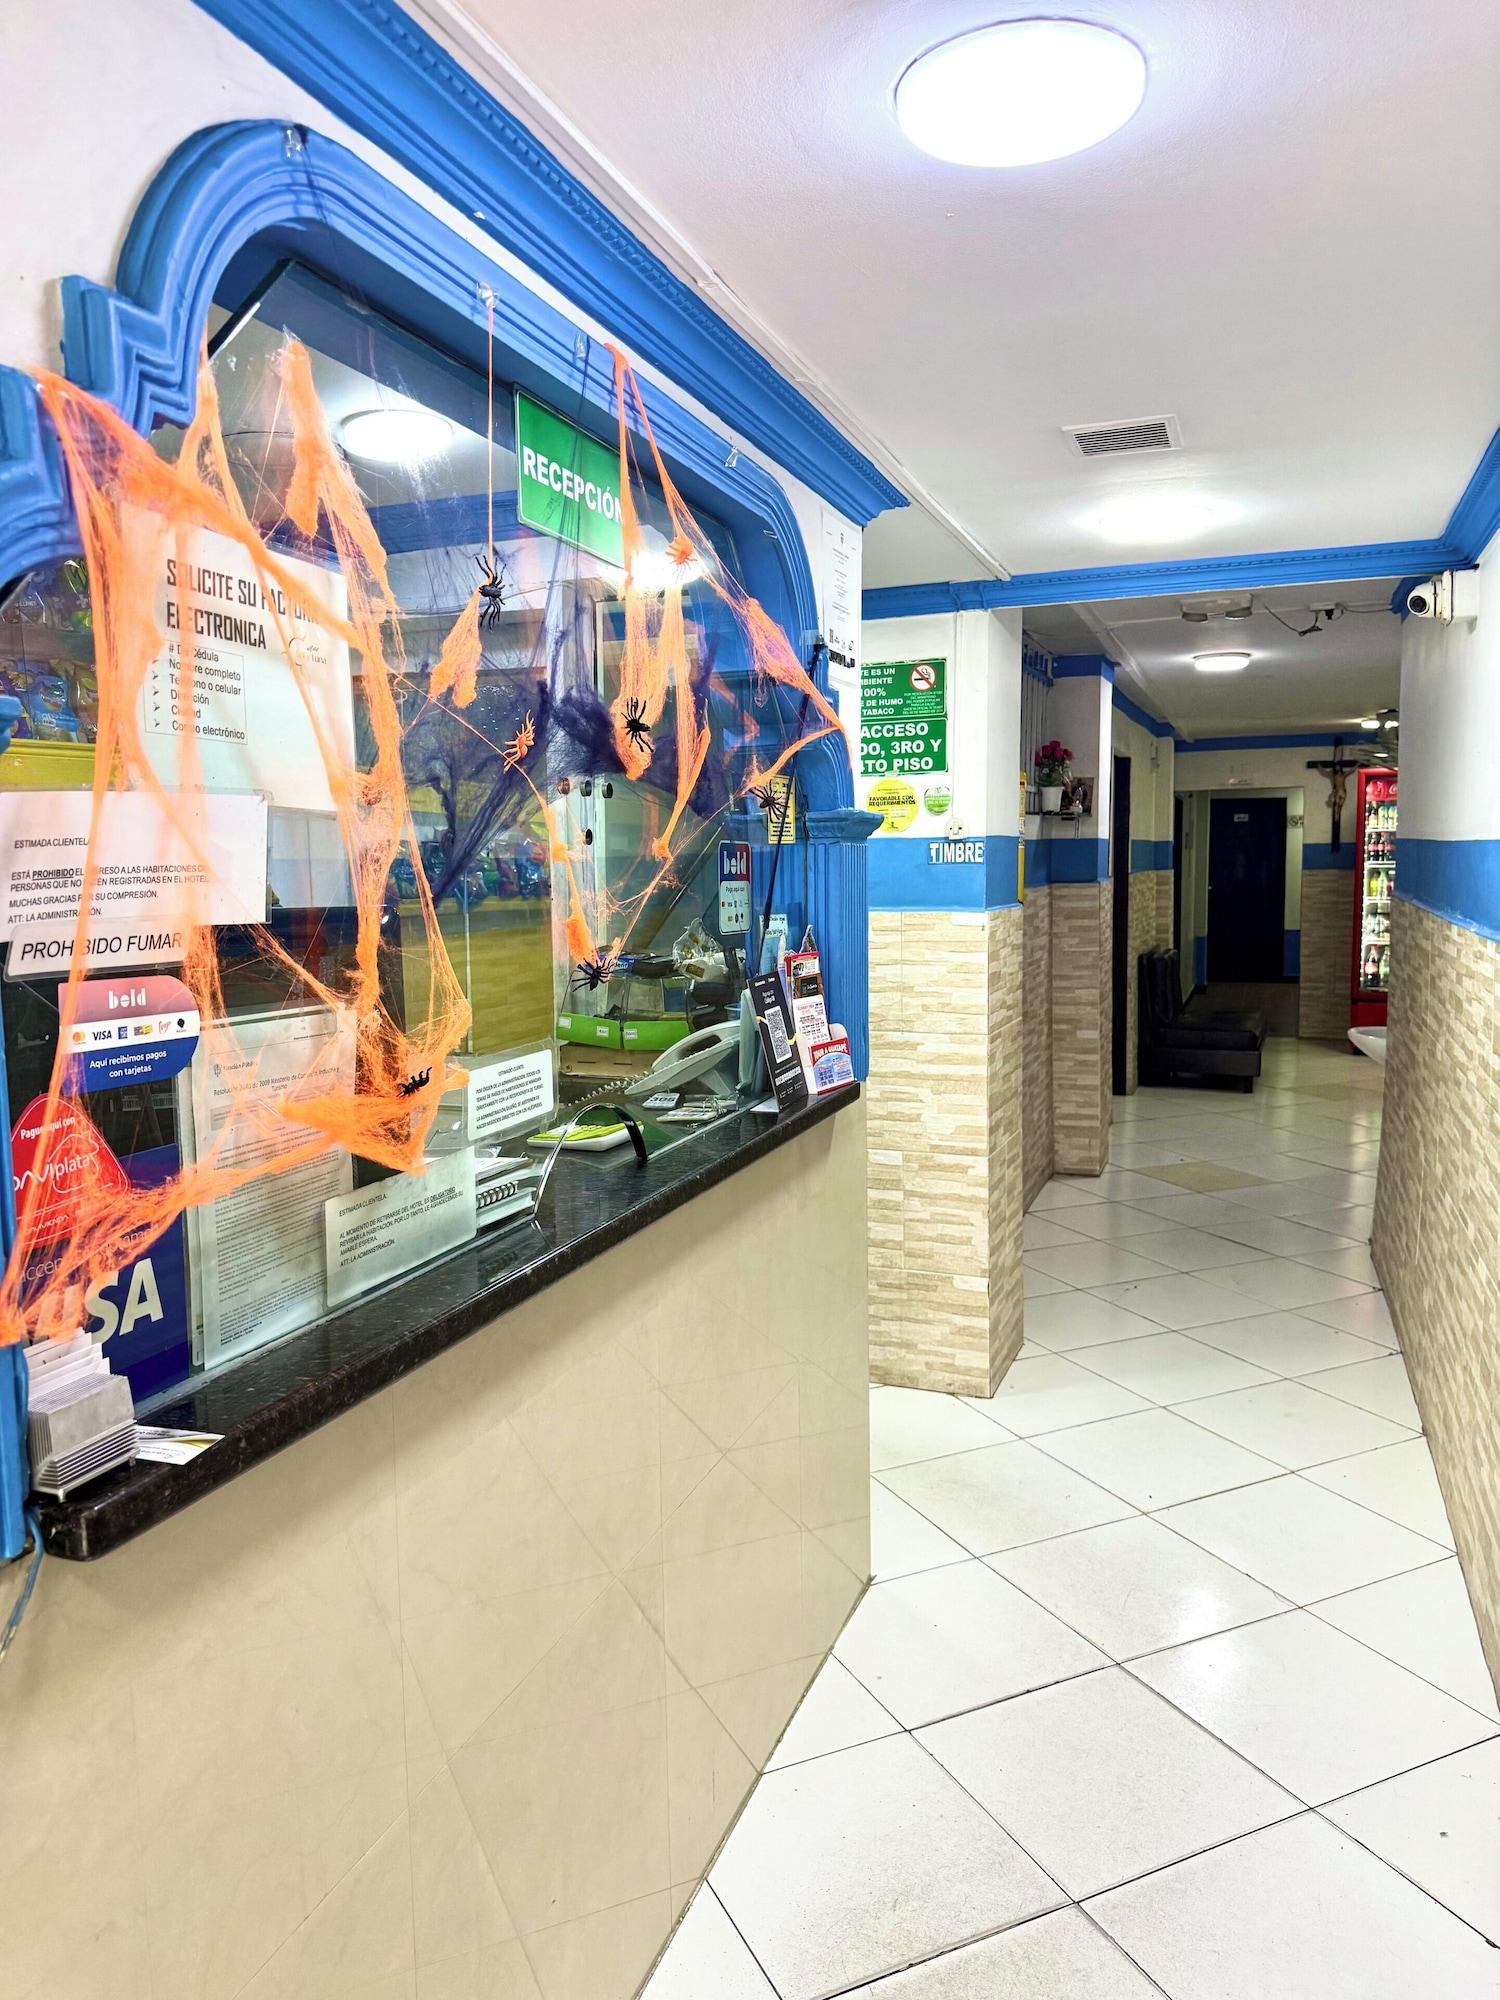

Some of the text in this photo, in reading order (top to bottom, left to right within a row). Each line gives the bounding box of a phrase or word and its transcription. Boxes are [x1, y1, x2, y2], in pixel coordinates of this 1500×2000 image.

[523, 446, 623, 523] RECEPCIÓN
[167, 559, 234, 601] SOLICITE
[238, 579, 257, 607] SU
[167, 601, 267, 649] ELECTRONICA
[204, 667, 242, 681] completo
[871, 668, 881, 676] ES
[883, 667, 896, 675] UN
[861, 677, 893, 685] BIENTE
[215, 682, 241, 696] celular
[866, 699, 877, 707] DE
[878, 698, 903, 706] HUMO
[862, 707, 894, 715] TABACO
[202, 726, 245, 740] electrónico
[861, 722, 929, 739] ACCESO
[890, 740, 925, 754] 3RO
[930, 739, 942, 752] Y
[893, 756, 933, 772] PISO
[14, 839, 51, 849] ESTIMADA
[930, 842, 985, 864] TIMBRE
[723, 851, 747, 875] bold
[11, 868, 31, 880] ESTÁ
[32, 868, 74, 880] PROHIBIDO
[75, 867, 84, 876] EL
[142, 864, 197, 873] HABITACIONES
[10, 881, 51, 892] PERSONAS
[52, 880, 69, 889] QUE
[70, 879, 82, 887] NO
[109, 876, 162, 886] REGISTRADAS
[9, 898, 42, 908] MUCHAS
[43, 895, 77, 904] GRACIAS
[95, 893, 107, 901] SU
[8, 915, 24, 924] ATT:
[21, 932, 183, 961] PROHBIDO FUMAR
[108, 988, 147, 1010] bold
[92, 1030, 112, 1041] VISA
[90, 1050, 167, 1069] Aquí recibimos pagos
[109, 1065, 152, 1078] con tarjetas
[62, 1117, 75, 1126] con
[339, 1202, 362, 1217] ESTIMADA
[346, 1222, 369, 1237] MOMENTO
[369, 1219, 376, 1227] DE
[376, 1209, 401, 1224] RETIRARSE
[401, 1205, 410, 1214] DEL
[340, 1234, 360, 1247] REVISAR
[360, 1230, 366, 1239] LA
[394, 1216, 403, 1224] POR
